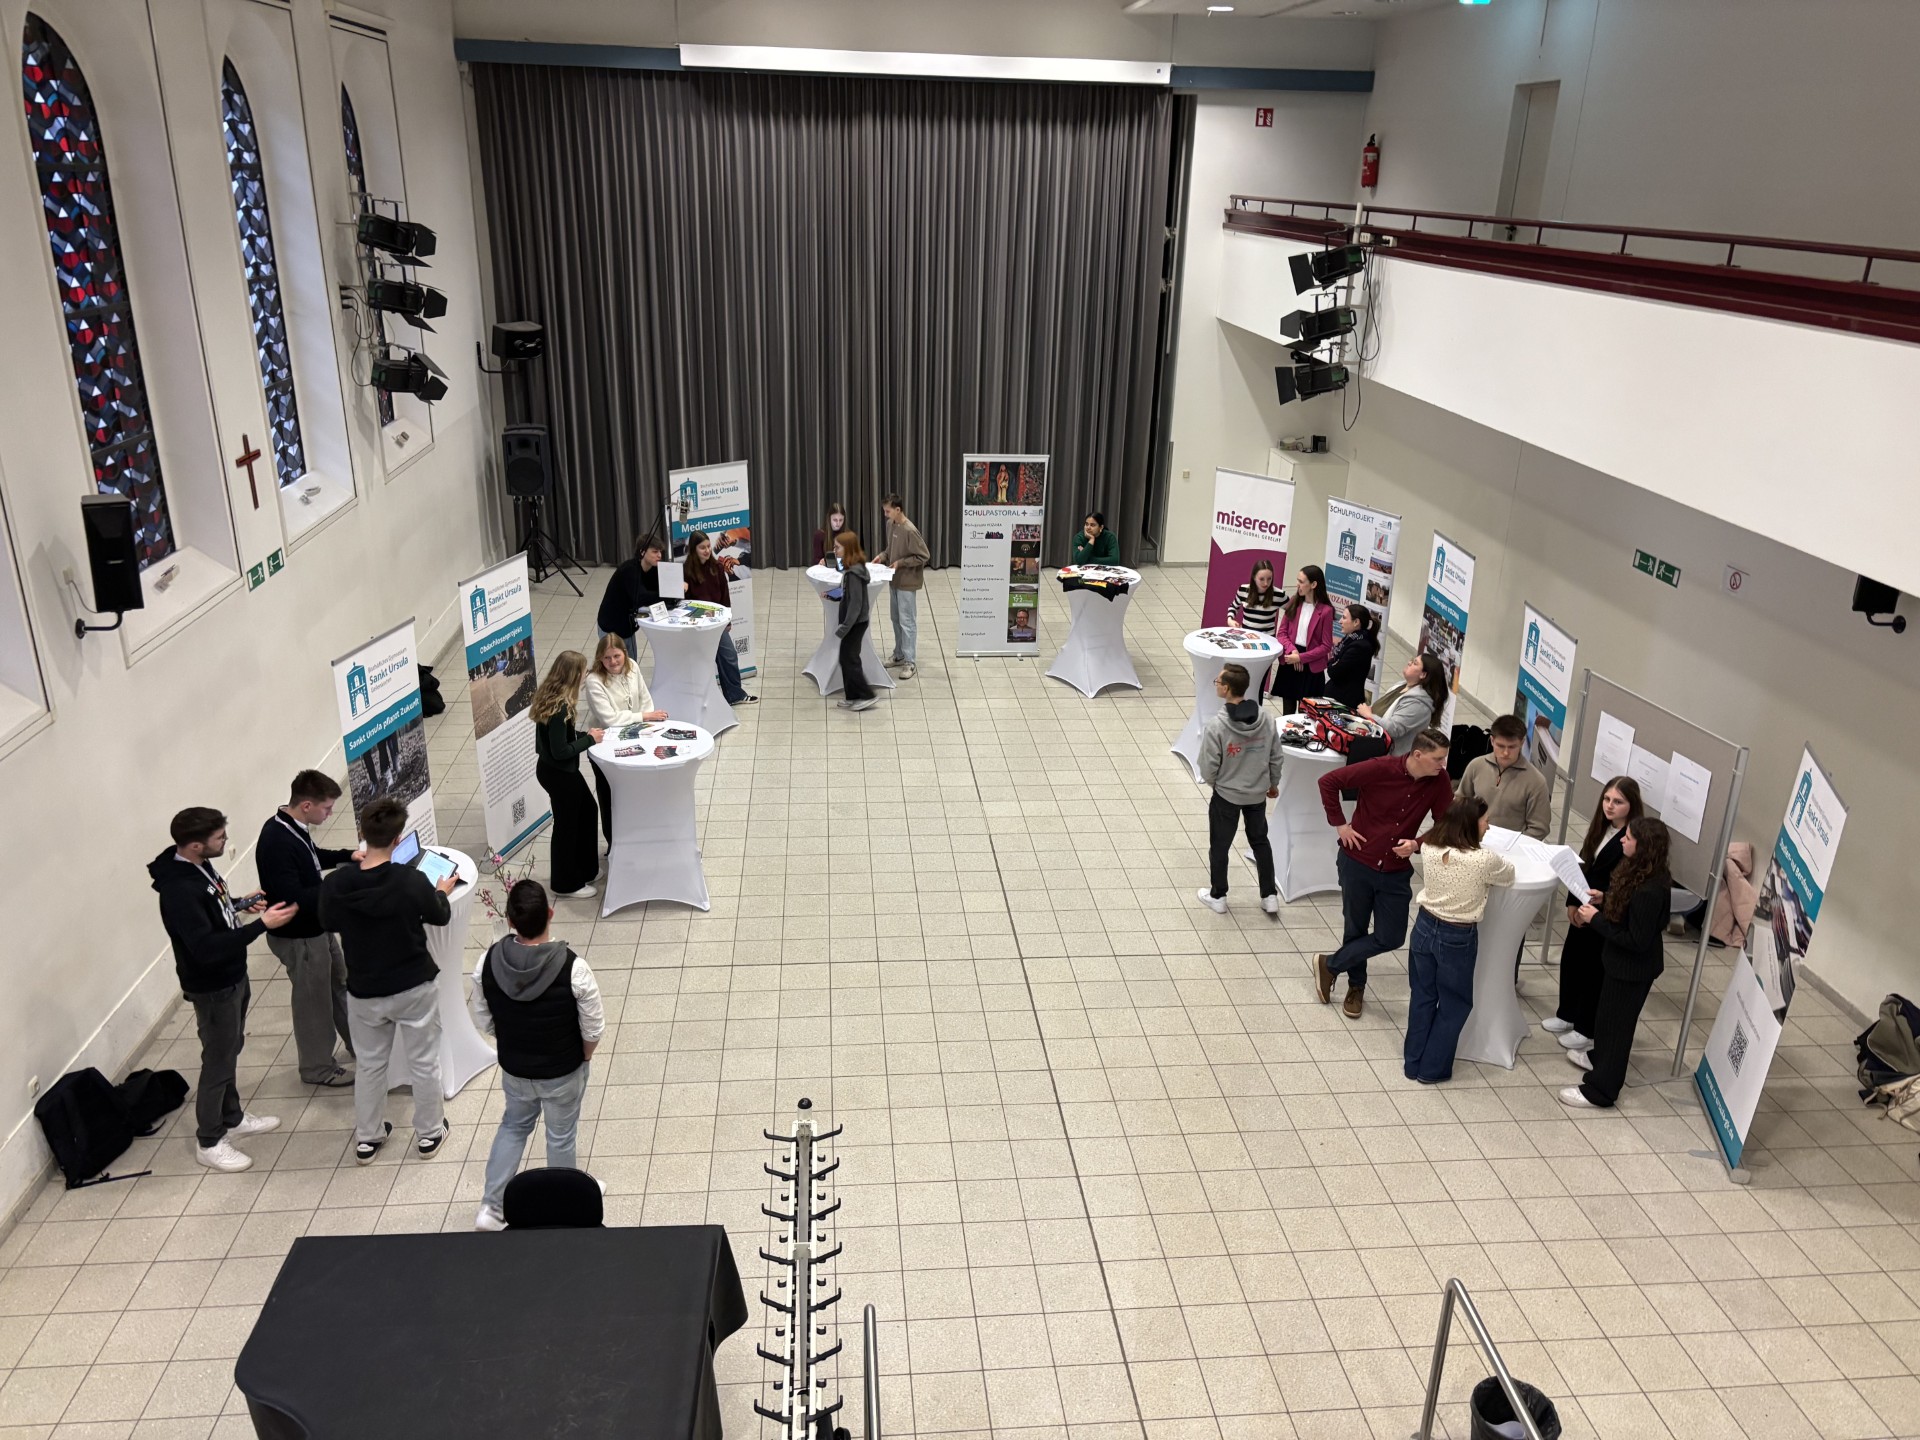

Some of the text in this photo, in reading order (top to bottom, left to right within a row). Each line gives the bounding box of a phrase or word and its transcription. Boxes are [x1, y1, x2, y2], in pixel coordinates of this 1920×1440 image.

[701, 485, 739, 497] Sankt Ursula
[964, 509, 1020, 517] SCHULPASTORAL
[1330, 505, 1375, 524] SCHULPROJEKT
[681, 516, 741, 533] Medienscouts
[1216, 510, 1287, 537] misereor
[488, 584, 522, 606] Sankt Ursula
[369, 656, 409, 686] Sankt Ursula
[349, 697, 420, 751] Sankt Ursula pflanzt Zukunft
